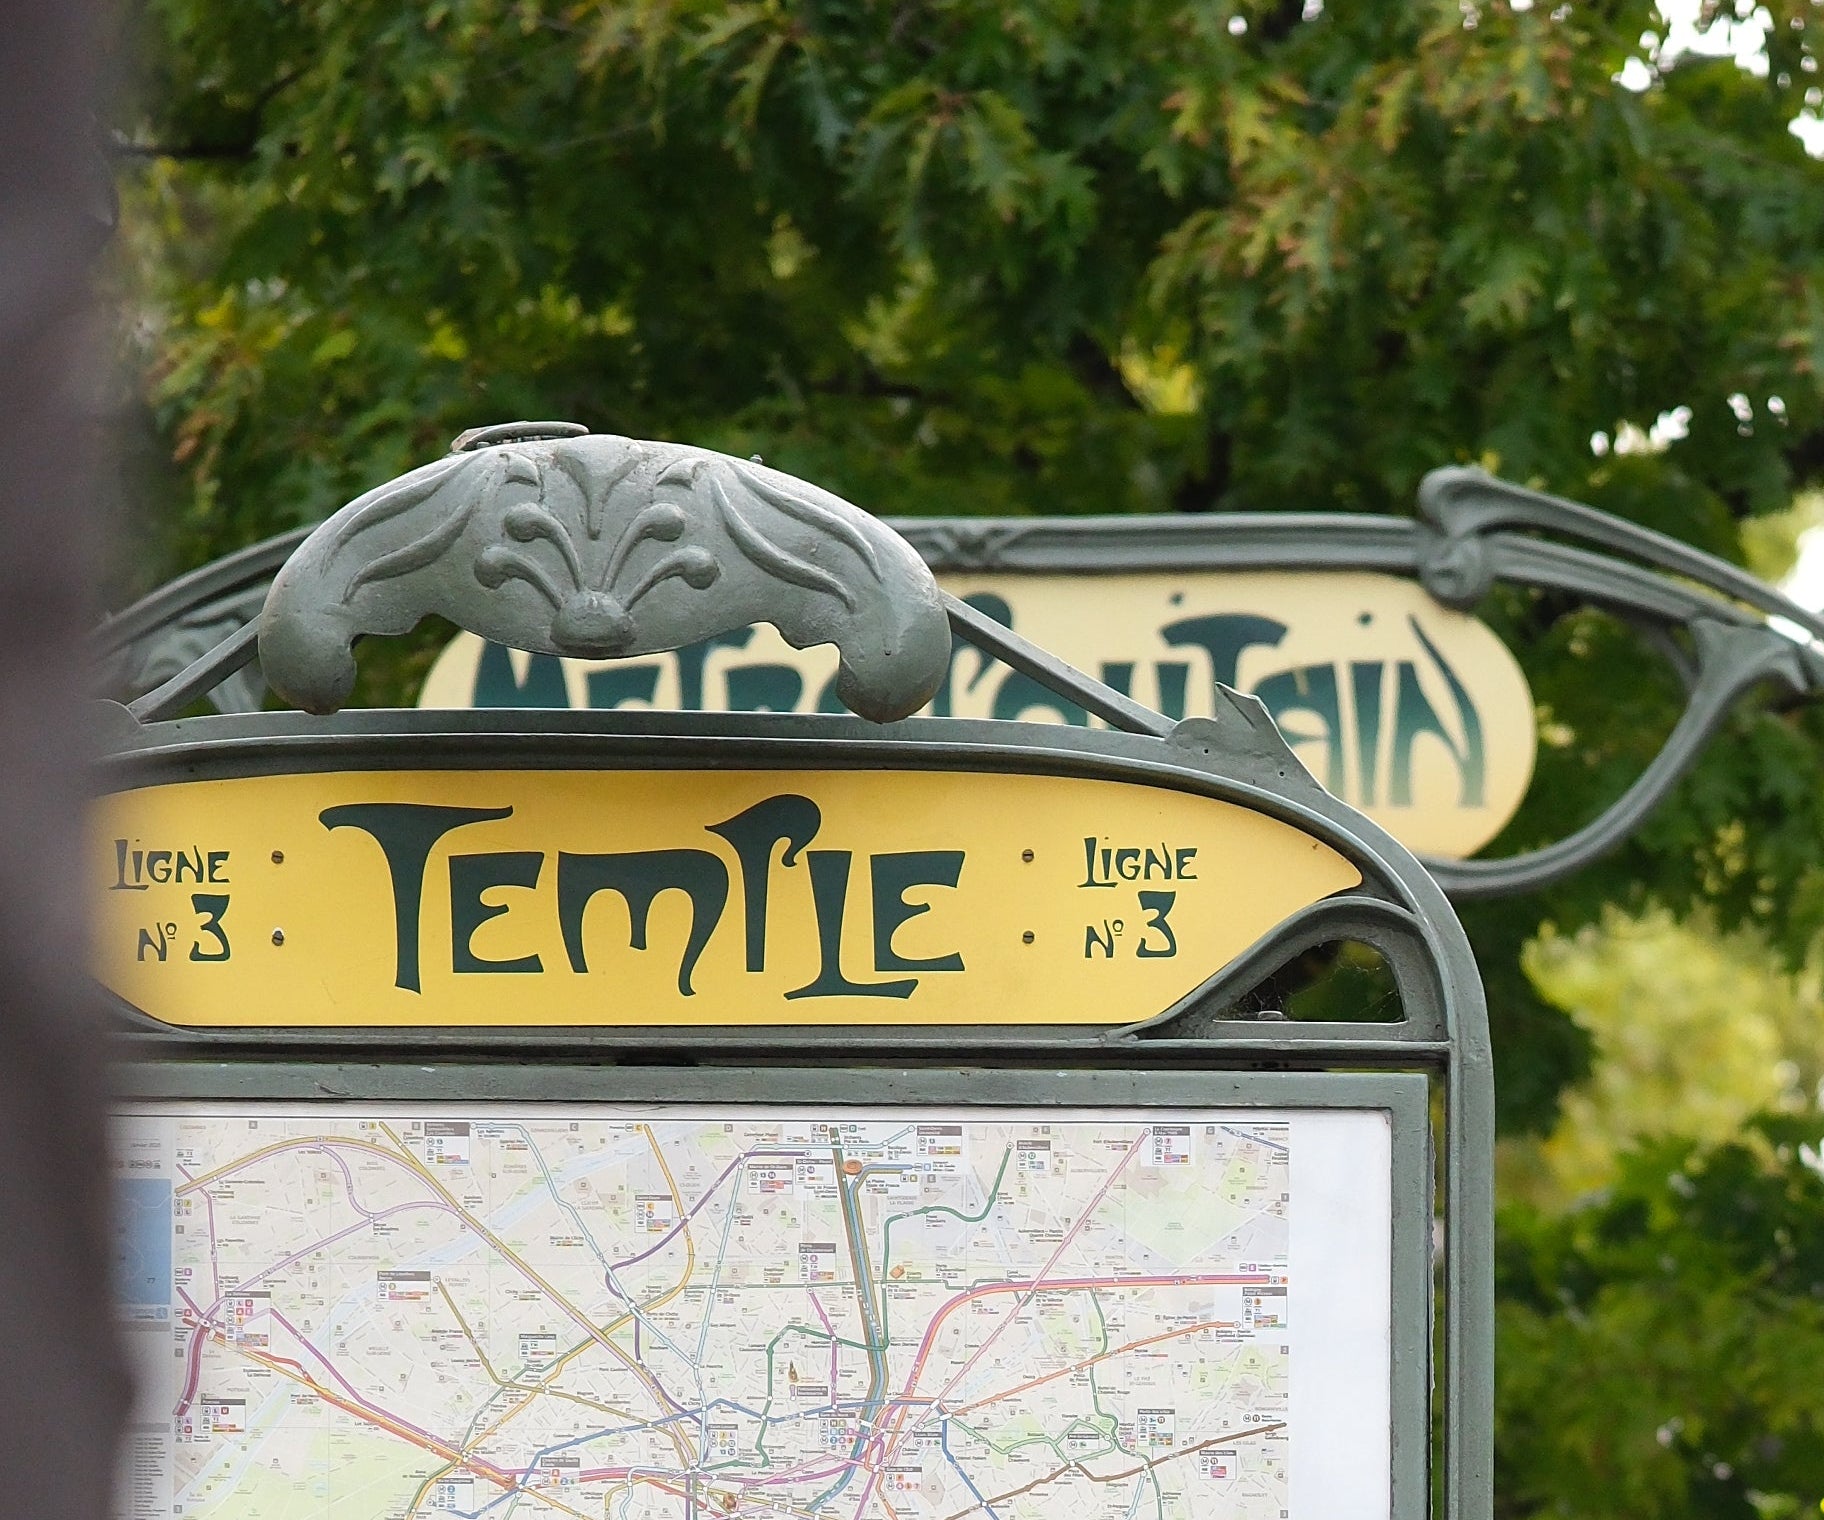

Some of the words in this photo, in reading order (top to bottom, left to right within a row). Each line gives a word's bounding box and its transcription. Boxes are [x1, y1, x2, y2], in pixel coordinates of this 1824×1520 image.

[189, 893, 231, 962] 3
[318, 793, 966, 1000] TEMPLE
[1136, 890, 1177, 958] 3
